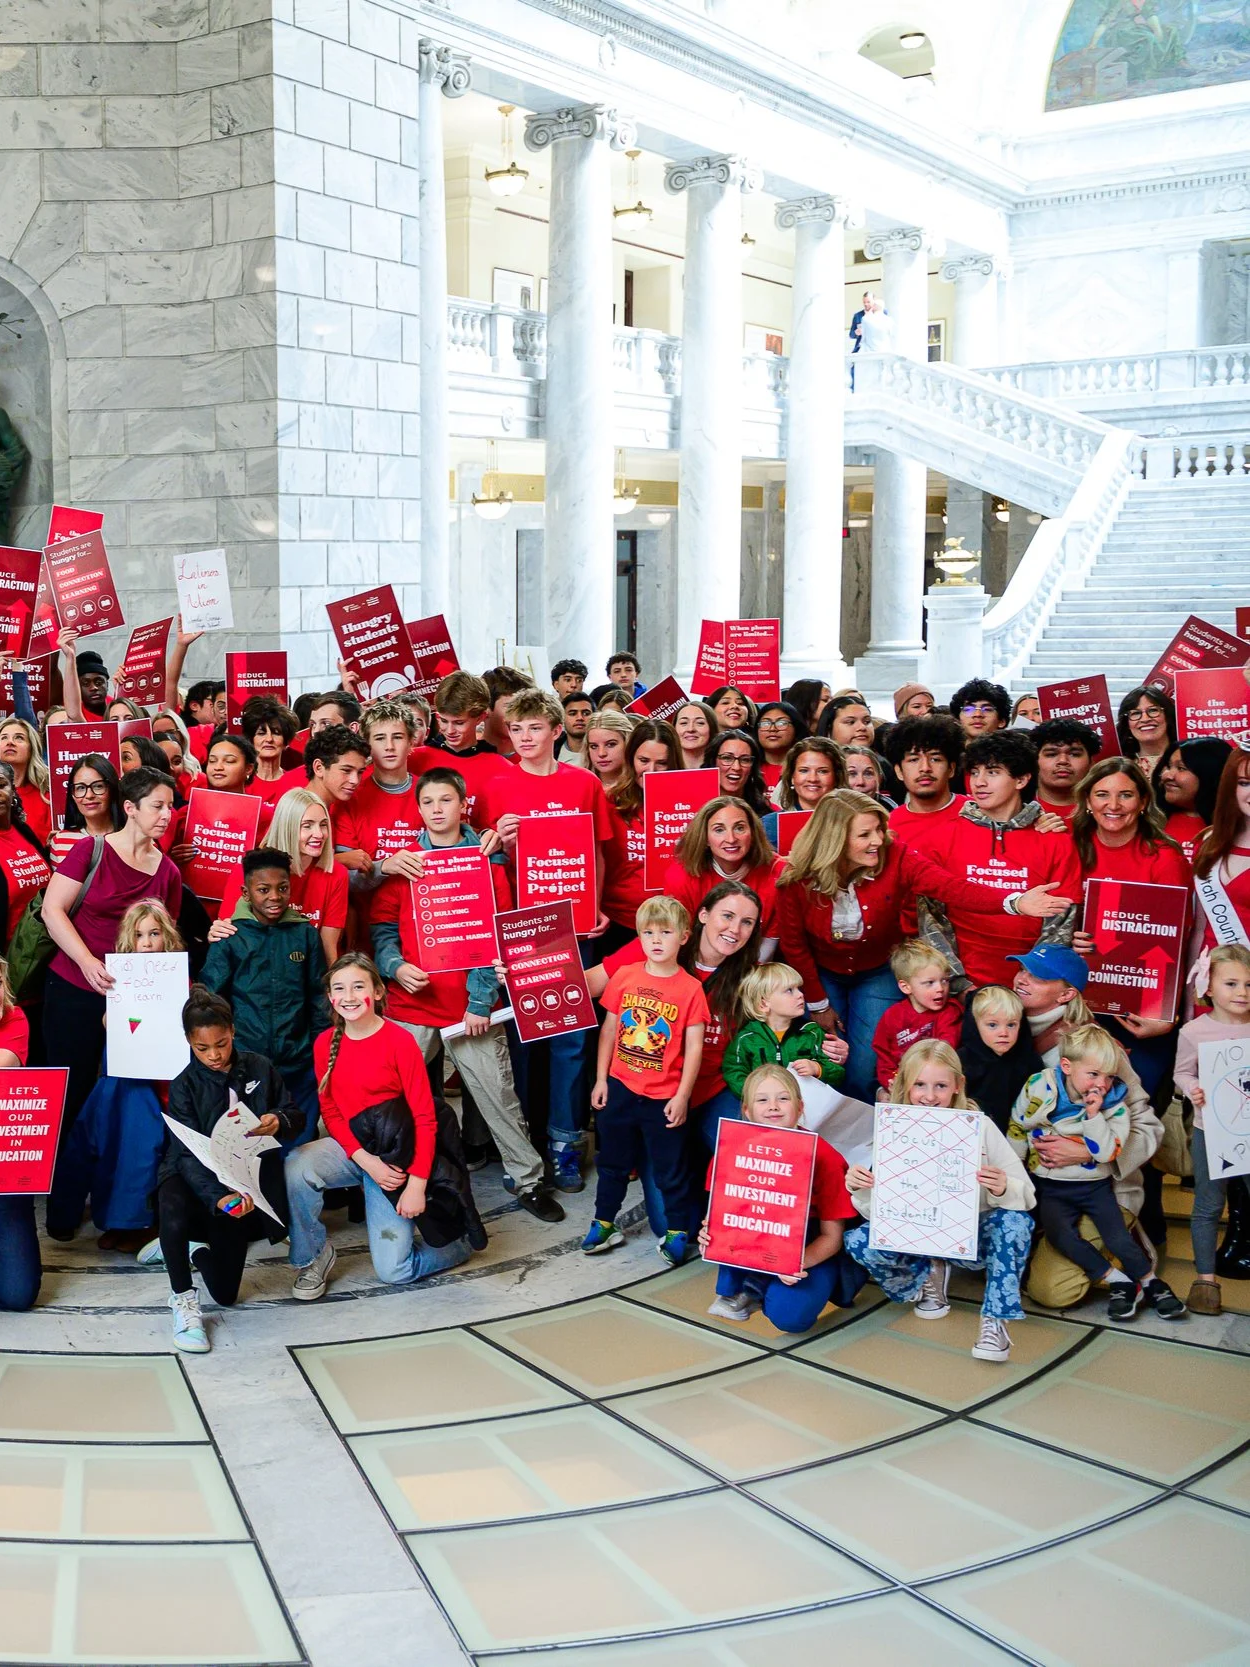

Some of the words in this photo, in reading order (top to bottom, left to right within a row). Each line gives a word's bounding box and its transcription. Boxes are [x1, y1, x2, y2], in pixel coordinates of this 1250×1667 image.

[49, 545, 80, 560] Students
[80, 541, 92, 551] are
[51, 555, 76, 566] hungry
[56, 567, 75, 578] FOOD
[58, 570, 104, 589] CONNECTION
[61, 585, 97, 600] LEARNING
[341, 613, 393, 635] Hungry
[344, 624, 400, 648] students
[1183, 630, 1213, 650] hungry
[1188, 624, 1223, 648] Students
[353, 636, 398, 658] cannot
[1177, 643, 1201, 658] FOOD
[359, 651, 399, 670] learn.
[237, 678, 285, 688] DISTRACTION
[1207, 699, 1225, 707] the
[1049, 702, 1101, 719] Hungry
[1186, 704, 1248, 718] Focused
[1186, 718, 1249, 730] Student
[674, 802, 691, 811] the
[214, 820, 230, 829] the
[395, 820, 409, 828] the
[193, 824, 247, 841] Focused
[192, 836, 245, 853] Student
[548, 848, 566, 856] the
[6, 853, 42, 868] Focused
[448, 856, 481, 865] phones
[527, 854, 586, 868] Focused
[989, 859, 1007, 867] the
[12, 862, 49, 877] Student
[437, 864, 481, 874] limited...
[527, 868, 586, 881] Student
[966, 865, 1028, 878] Focused
[430, 882, 461, 891] ANXIETY
[527, 881, 586, 895] Project
[451, 894, 479, 902] SCORES
[433, 908, 469, 917] BULLYING
[1103, 910, 1151, 921] REDUCE
[435, 920, 483, 930] CONNECTION
[502, 917, 543, 931] Students
[543, 913, 558, 923] are
[1101, 919, 1177, 937] DISTRACTION
[437, 935, 465, 944] SEXUAL
[466, 932, 492, 940] HARMS
[503, 926, 537, 940] hungry
[508, 944, 533, 956] FOOD
[144, 958, 179, 975] need
[511, 952, 570, 971] CONNECTION
[1101, 963, 1159, 976] INCREASE
[515, 970, 562, 987] LEARNING
[1087, 971, 1158, 989] CONNECTION
[108, 993, 123, 1003] to
[134, 993, 163, 1002] learn
[9, 1087, 39, 1095] LET'S
[8, 1114, 33, 1122] OUR
[892, 1121, 937, 1147] Focus
[10, 1139, 22, 1147] IN
[748, 1143, 783, 1157] LET'S
[735, 1155, 793, 1177] MAXIMIZE
[748, 1174, 776, 1186] OUR
[900, 1178, 919, 1190] the
[724, 1183, 797, 1208] INVESTMENT
[752, 1205, 766, 1215] IN
[879, 1203, 938, 1222] students!
[723, 1213, 791, 1237] EDUCATION
